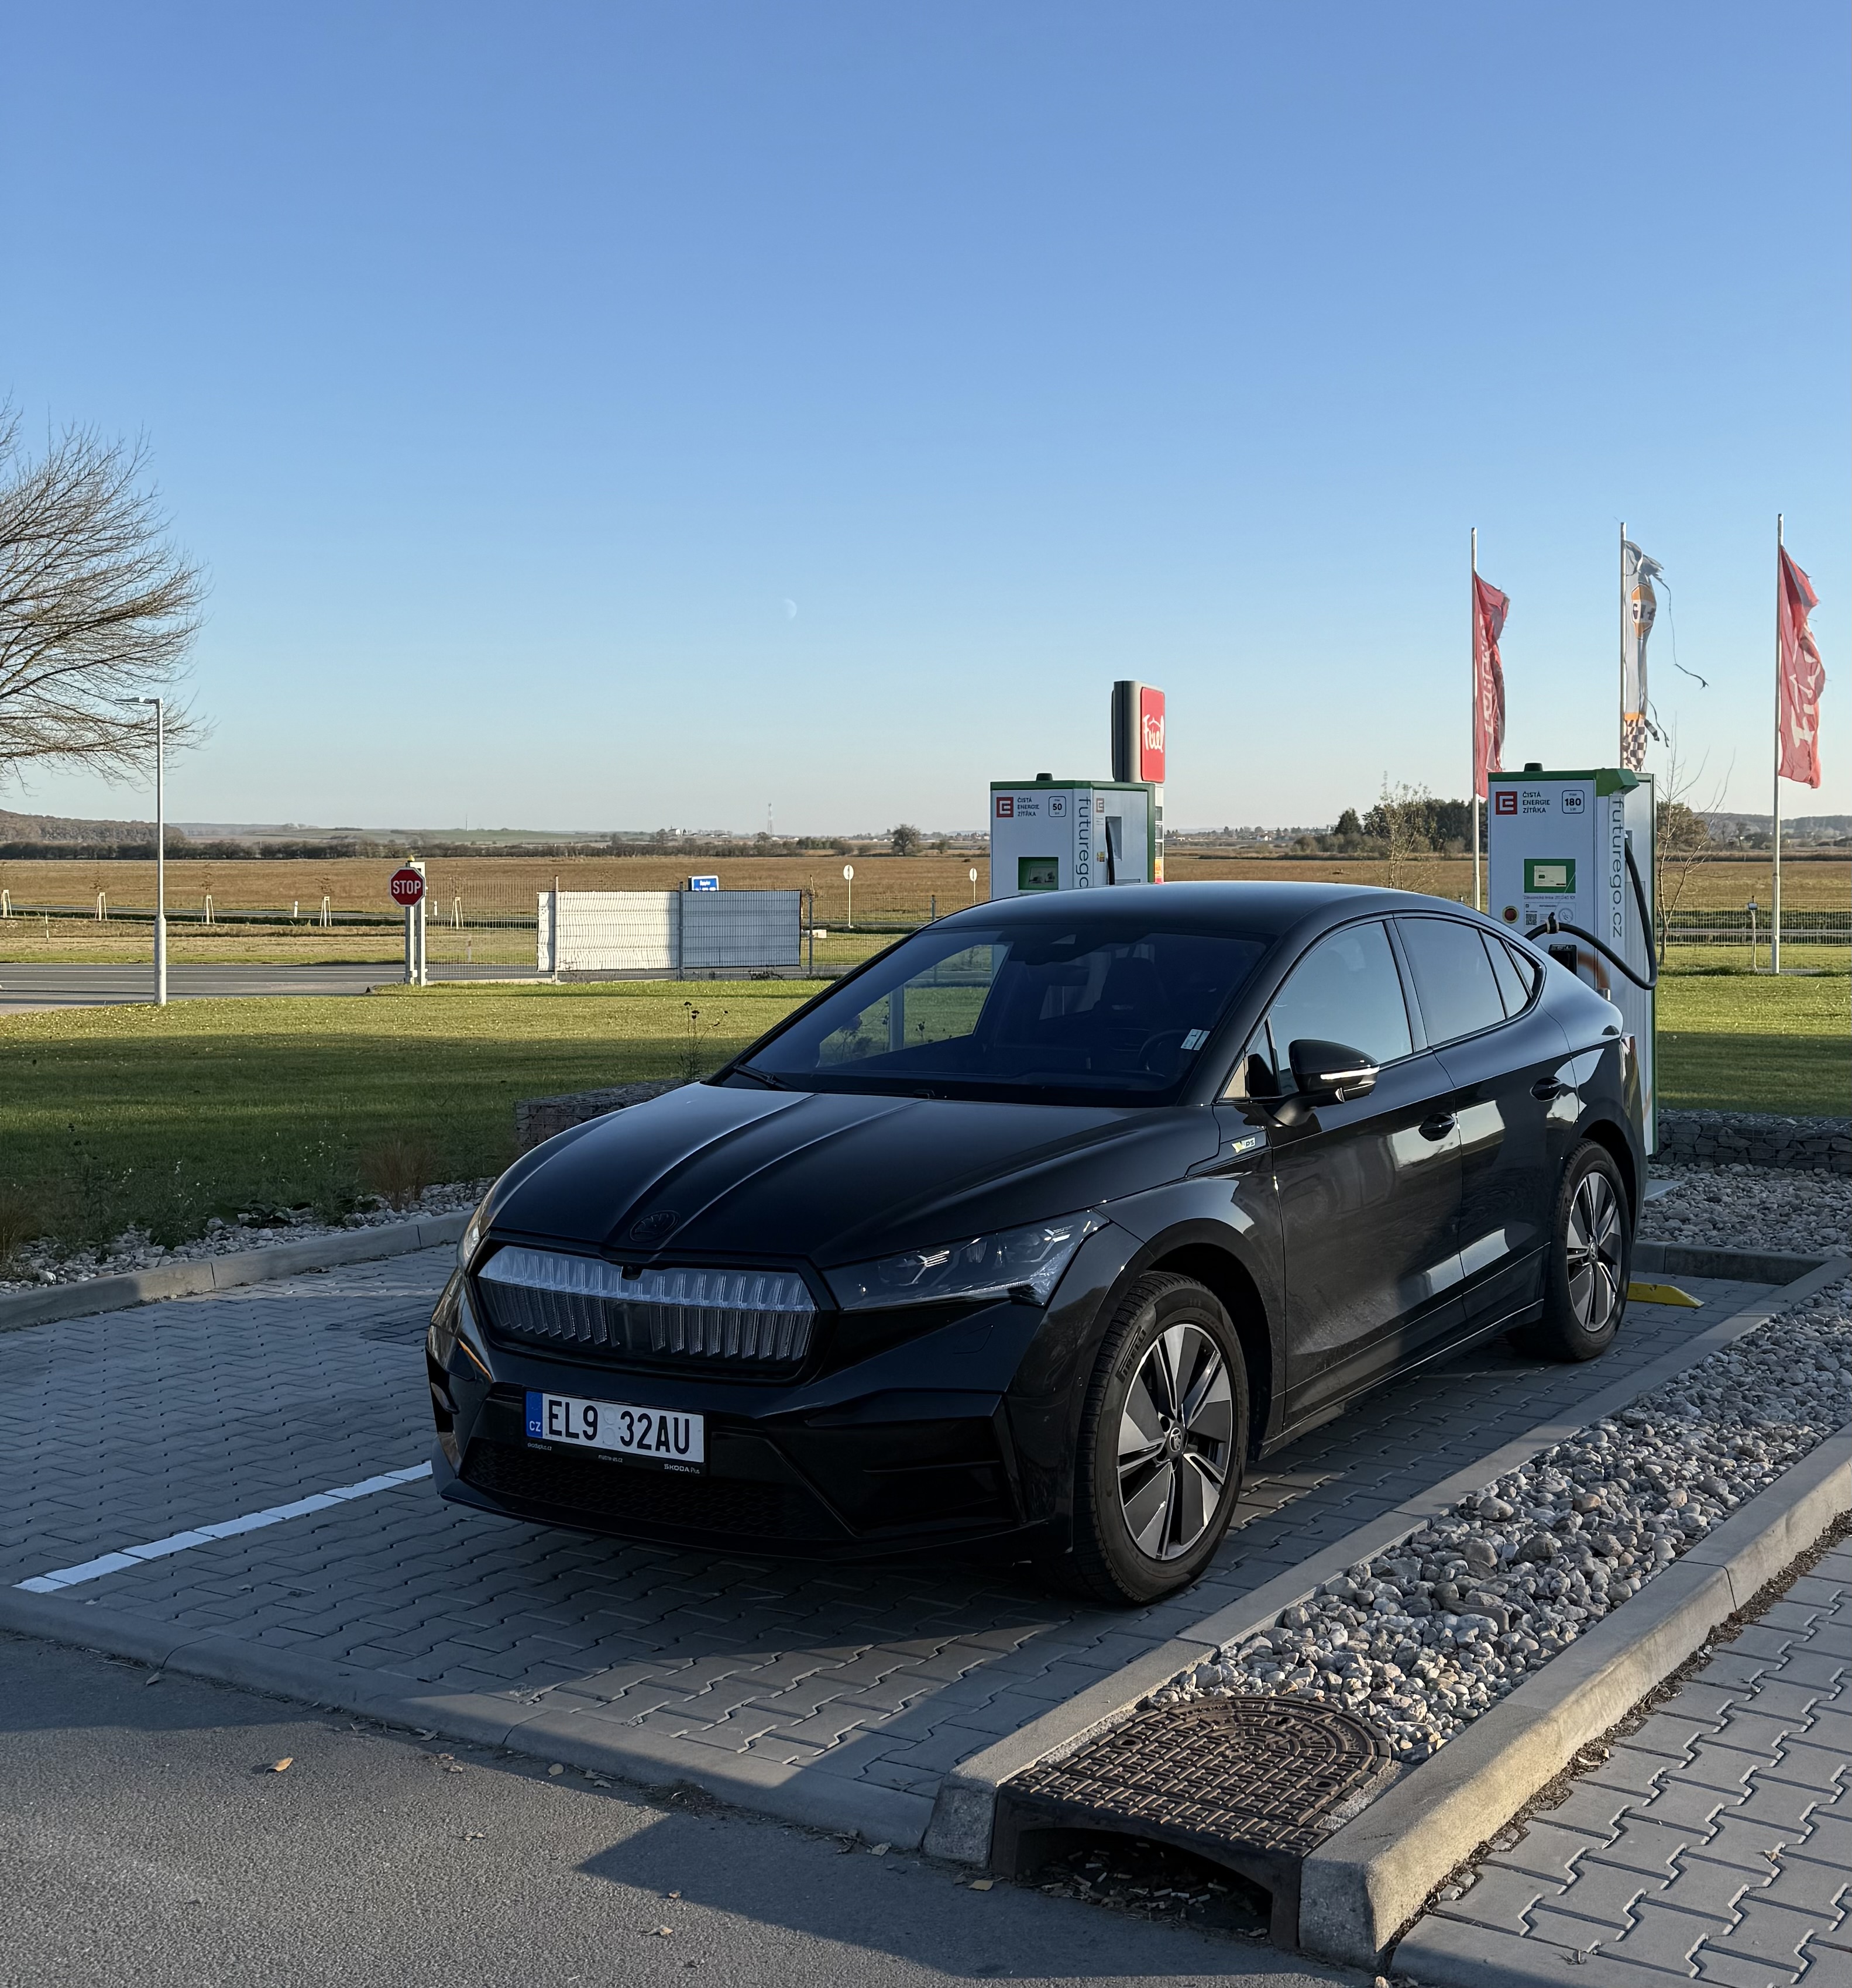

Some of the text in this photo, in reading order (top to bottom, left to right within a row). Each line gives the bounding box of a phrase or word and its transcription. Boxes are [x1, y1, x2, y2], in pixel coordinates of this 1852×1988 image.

[1143, 714, 1164, 753] Fuel
[1565, 798, 1582, 806] 180
[393, 880, 421, 895] STOP
[1610, 799, 1624, 938] futurego.cz
[1115, 1325, 1146, 1384] PIRELLI
[529, 1421, 541, 1432] CZ
[548, 1399, 690, 1455] EL9 32AU
